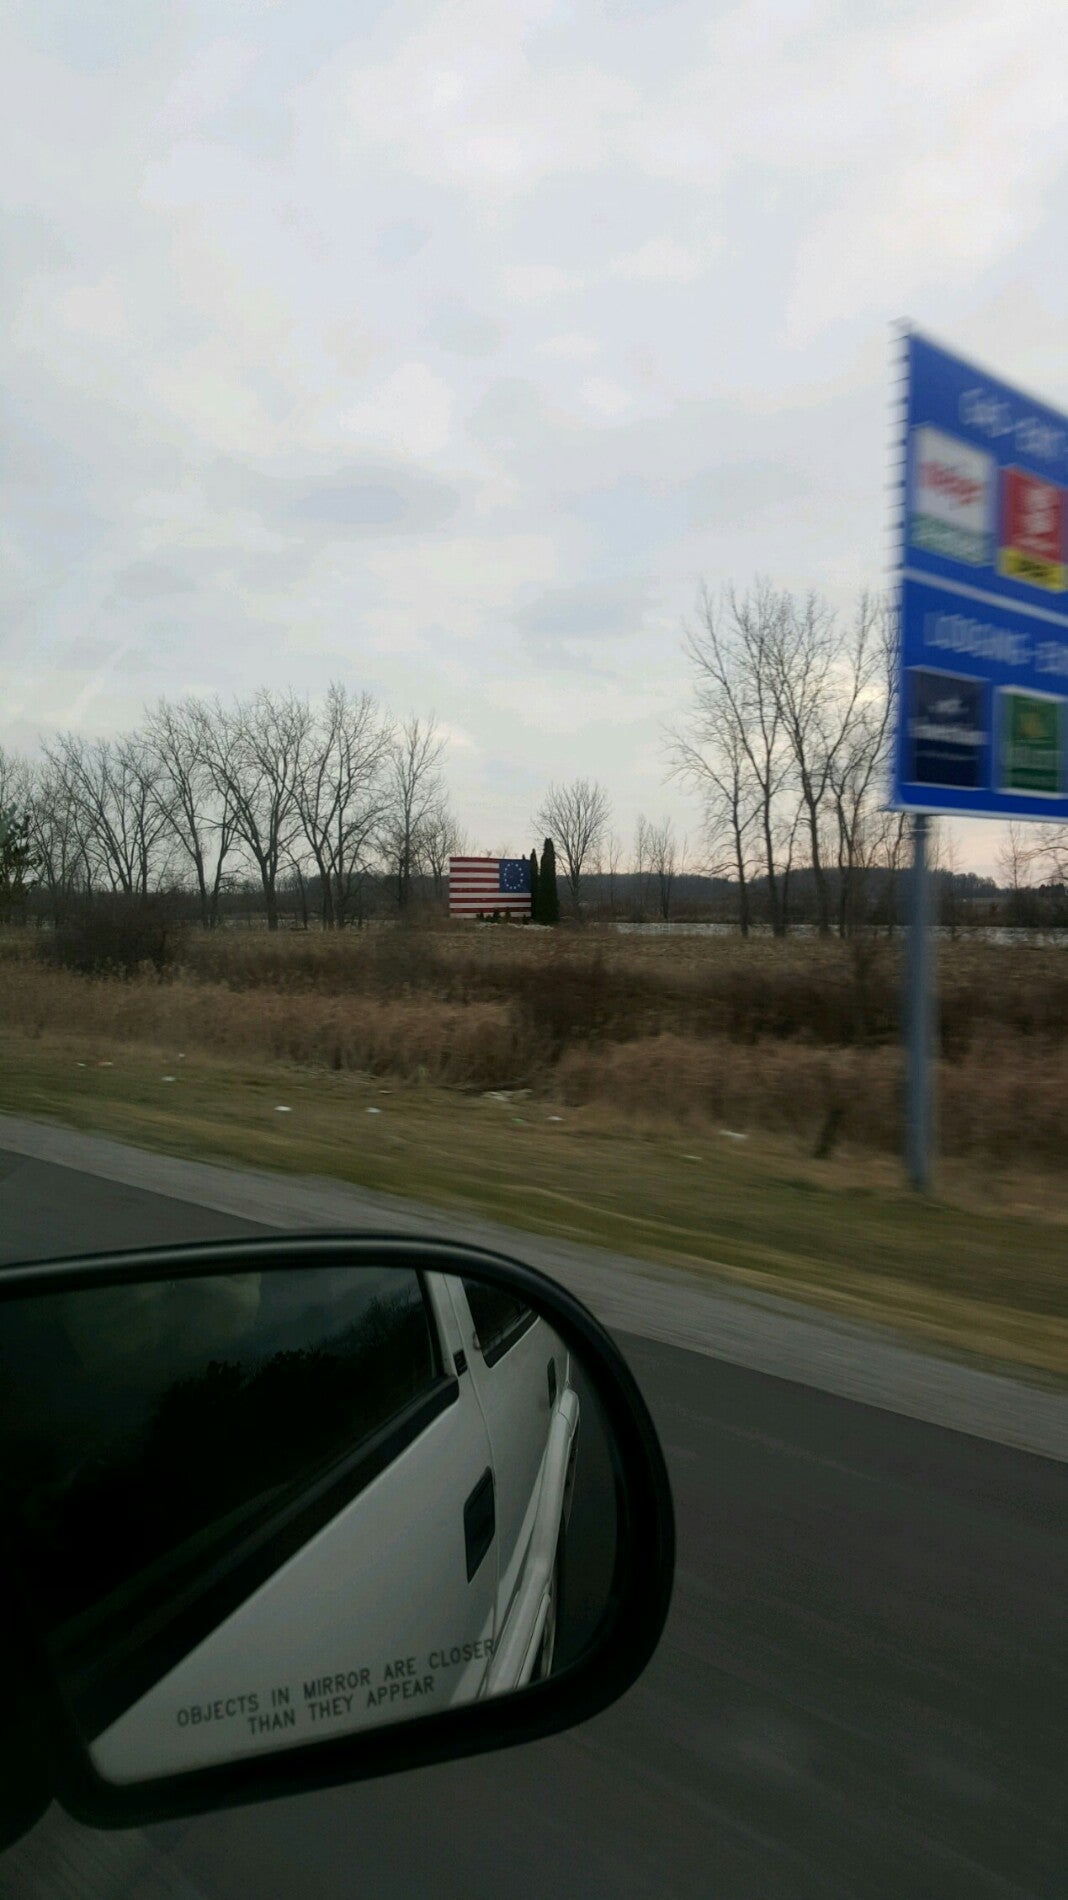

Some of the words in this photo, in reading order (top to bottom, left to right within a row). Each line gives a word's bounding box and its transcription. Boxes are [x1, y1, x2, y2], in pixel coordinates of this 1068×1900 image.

[177, 1694, 258, 1726] OBJECTS
[272, 1687, 289, 1706] IN
[303, 1667, 370, 1699] MIRROR
[384, 1656, 416, 1681] ARE
[429, 1638, 494, 1670] CLOSER
[249, 1708, 295, 1735] THAN
[308, 1694, 353, 1720] THEY
[367, 1676, 434, 1708] APPEAR
